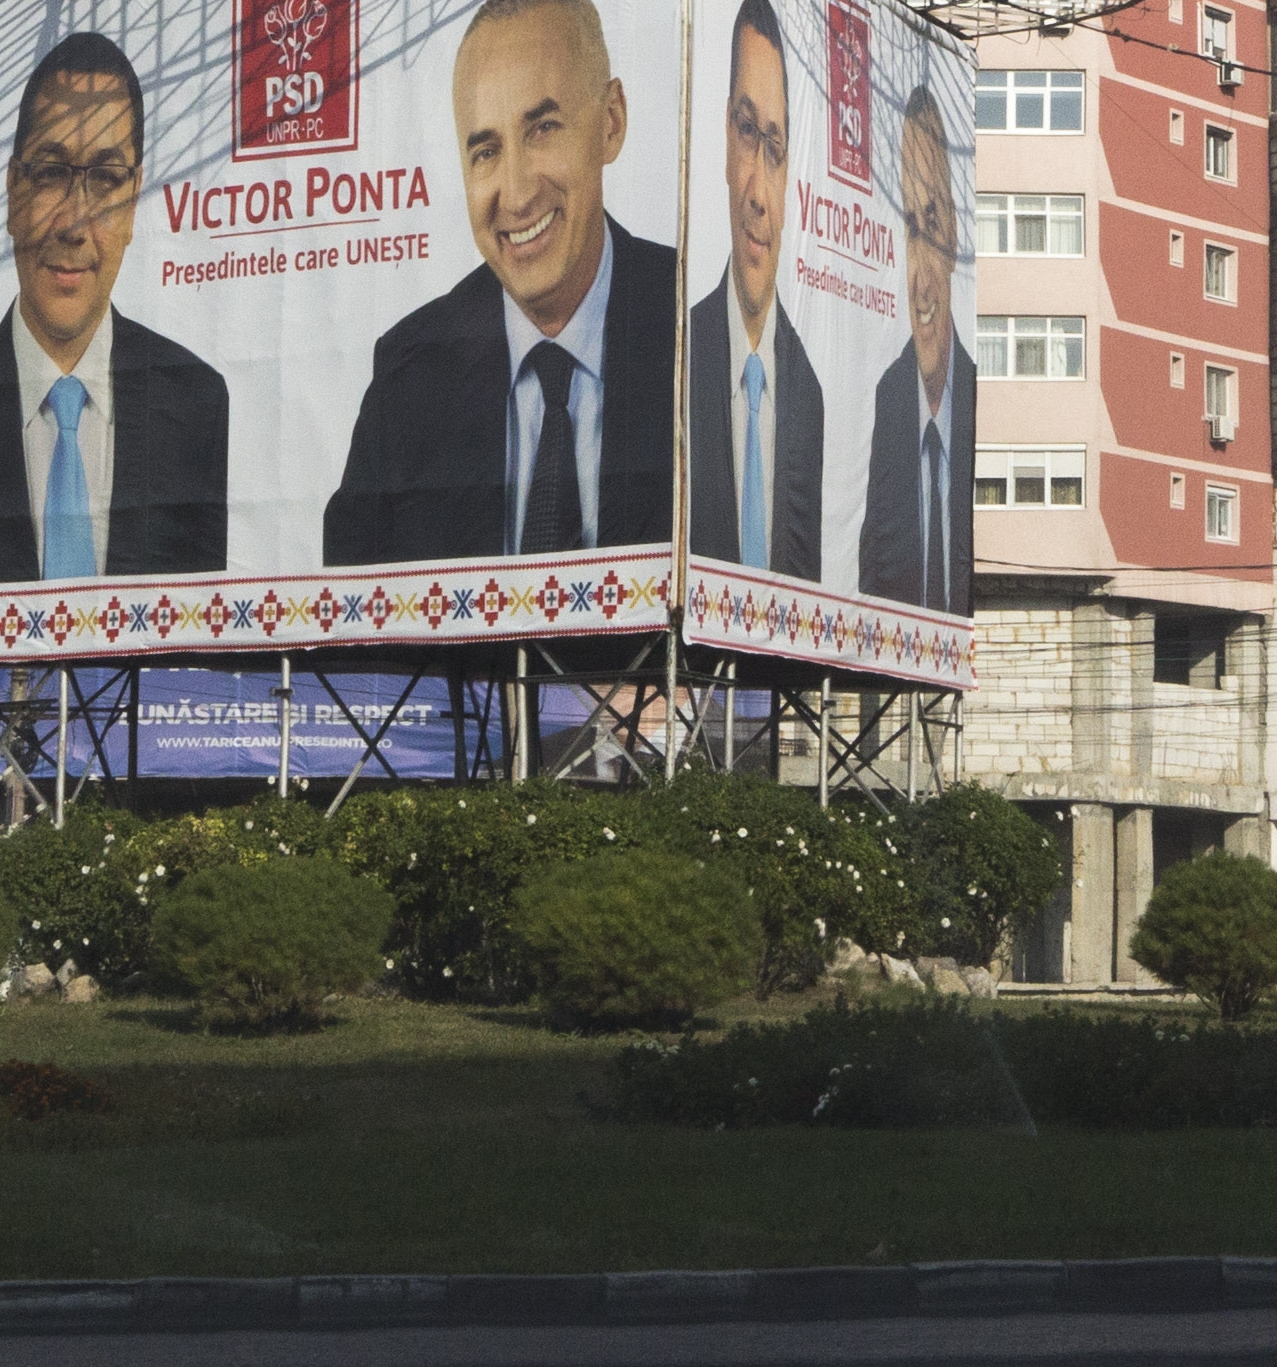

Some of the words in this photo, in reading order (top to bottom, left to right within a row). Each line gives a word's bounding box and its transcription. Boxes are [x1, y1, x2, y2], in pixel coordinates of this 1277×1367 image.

[265, 71, 324, 117] PSD
[839, 100, 862, 148] PSD
[163, 179, 293, 234] VICTOR
[306, 166, 430, 217] PONTA
[798, 179, 850, 249] VICTOR
[853, 203, 895, 268] PONTA
[162, 247, 287, 292] Președintele
[295, 246, 339, 271] care
[346, 233, 430, 269] UNEȘTE
[850, 283, 863, 307] care
[315, 704, 432, 726] RESPECT
